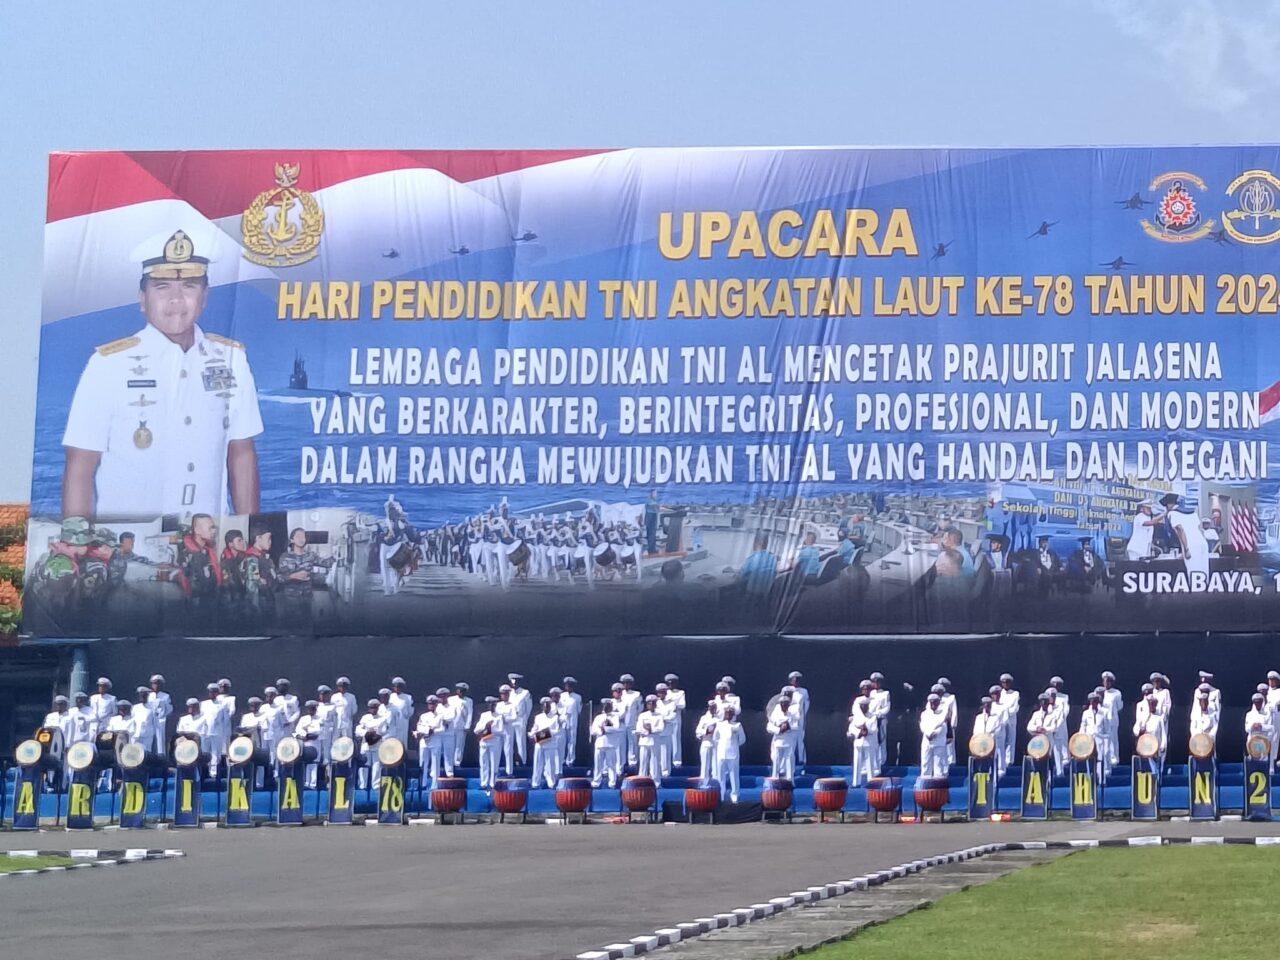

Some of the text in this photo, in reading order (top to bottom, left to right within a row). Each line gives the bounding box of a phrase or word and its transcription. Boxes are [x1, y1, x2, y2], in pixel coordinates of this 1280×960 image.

[658, 209, 919, 259] UPACARA
[277, 280, 361, 320] HARI
[372, 280, 587, 320] PENDIDIKAN
[598, 280, 657, 319] TNI
[667, 277, 862, 318] ANGKATAN
[873, 276, 965, 316] LAUT
[975, 275, 1073, 315] KE-78
[1084, 274, 1205, 314] TAHUN
[350, 341, 1222, 386] LEMBAGA PENDIDIKAN TNI AL MENCETAK PRAJURIT JALASENA
[309, 391, 1260, 440] YANG BERKARAKTER, BERINTEGRITAS, PROFESIONAL, DAN MODERN
[300, 440, 1268, 489] DALAM RANGKA MEWUJUDKAN TNI AL YANG HANDAL DAN DISEGANI
[1002, 501, 1045, 514] Sekolah
[1122, 570, 1263, 595] SURABAYA,
[381, 776, 404, 812] 78
